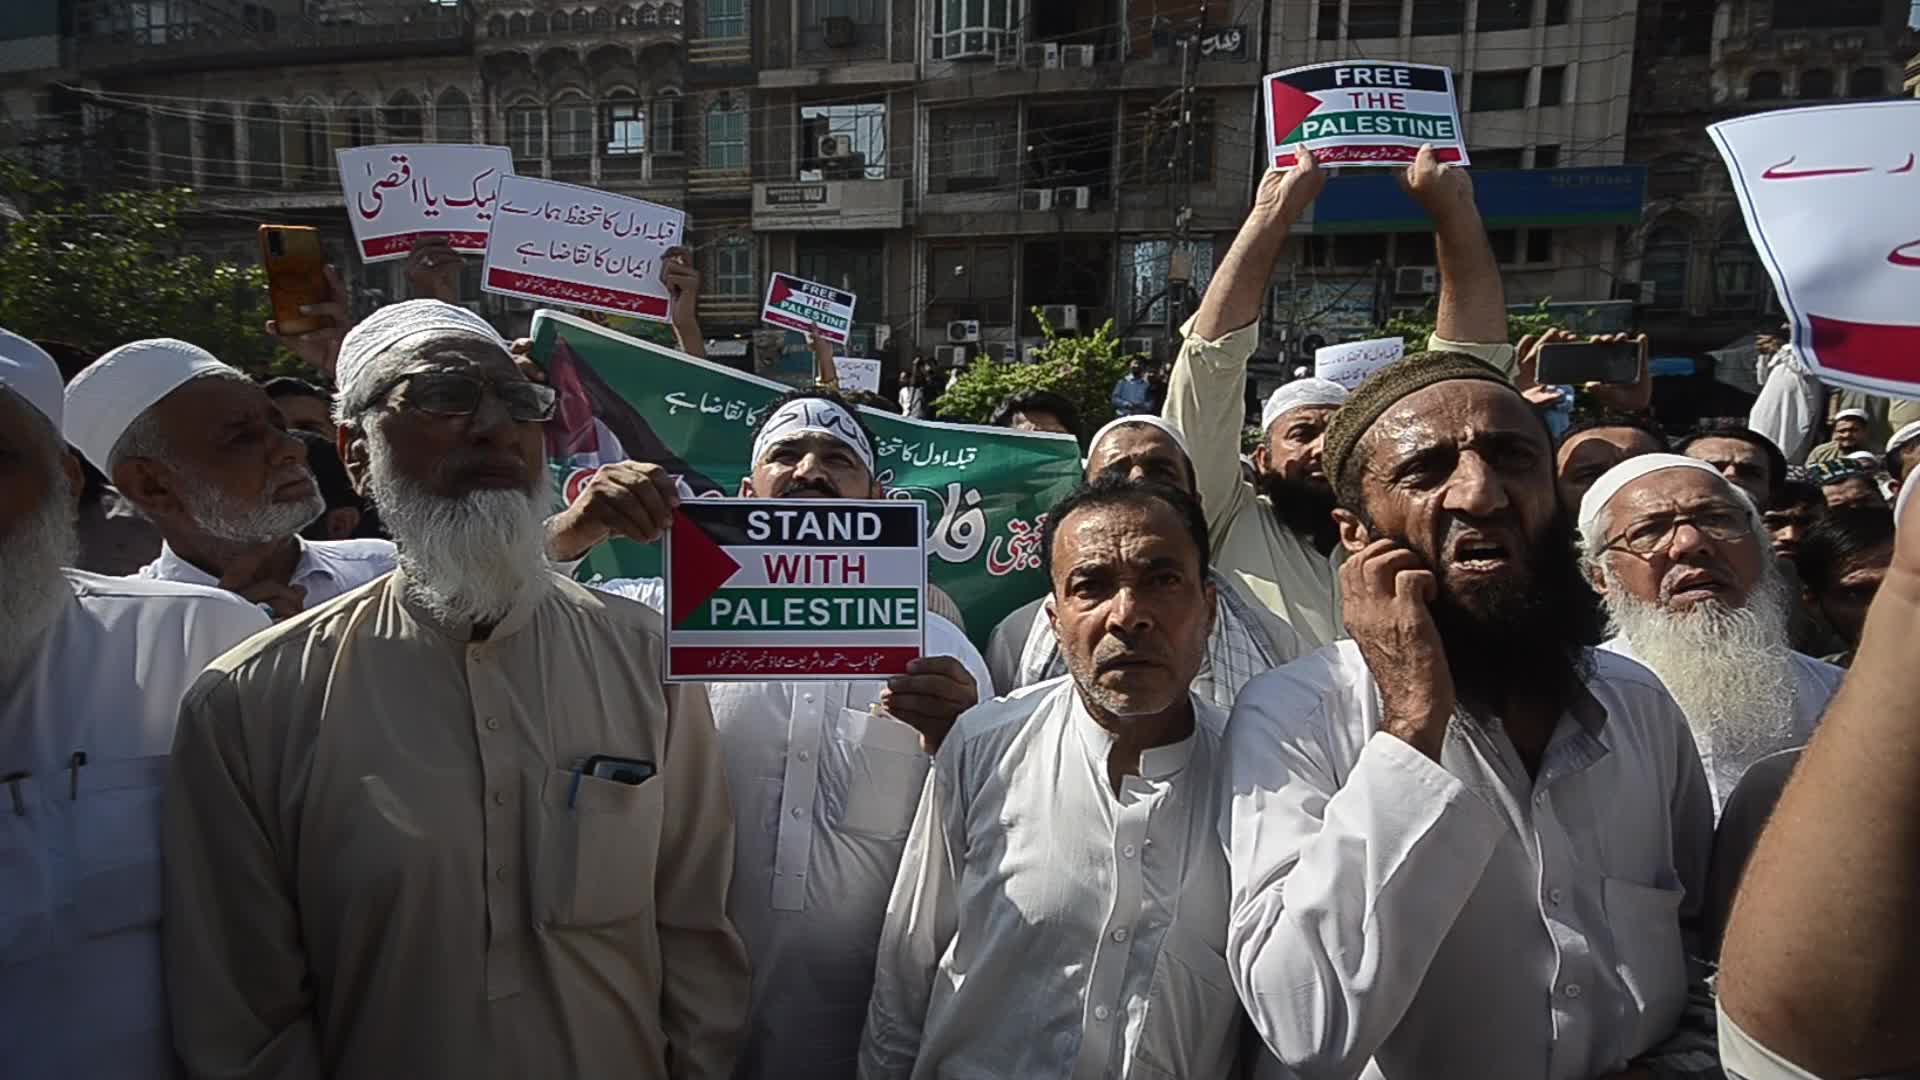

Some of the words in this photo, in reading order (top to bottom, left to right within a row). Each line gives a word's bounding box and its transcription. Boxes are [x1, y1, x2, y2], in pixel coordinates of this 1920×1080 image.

[1335, 68, 1412, 87] FREE
[1347, 92, 1408, 110] THE
[1302, 115, 1455, 138] PALESTINE
[802, 283, 837, 300] FREE
[805, 295, 832, 311] THE
[780, 301, 847, 328] PALESTINE
[747, 510, 882, 541] STAND
[763, 554, 866, 584] WITH
[711, 598, 917, 626] PALESTINE
